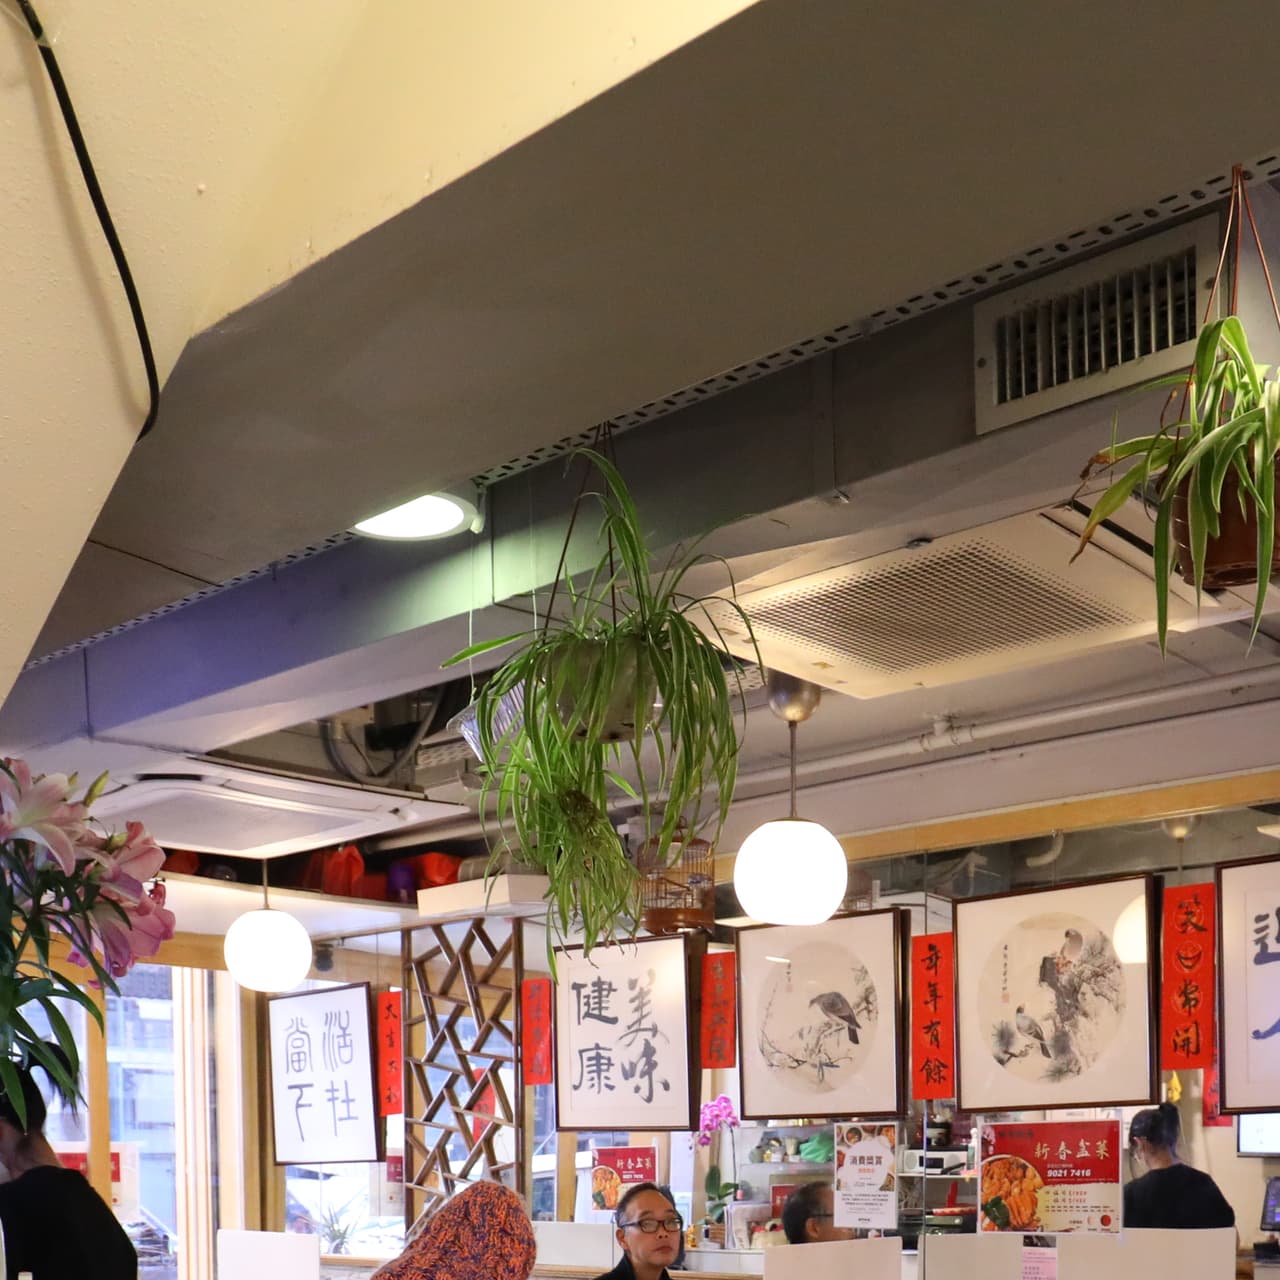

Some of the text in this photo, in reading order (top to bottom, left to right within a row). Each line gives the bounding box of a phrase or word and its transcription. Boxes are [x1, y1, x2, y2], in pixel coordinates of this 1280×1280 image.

[571, 975, 619, 1095] 健康
[618, 967, 670, 1104] 美味
[920, 943, 949, 1086] 年年有餘
[1173, 893, 1208, 1059] 笑口常開
[1034, 1138, 1109, 1160] 新春盆菜
